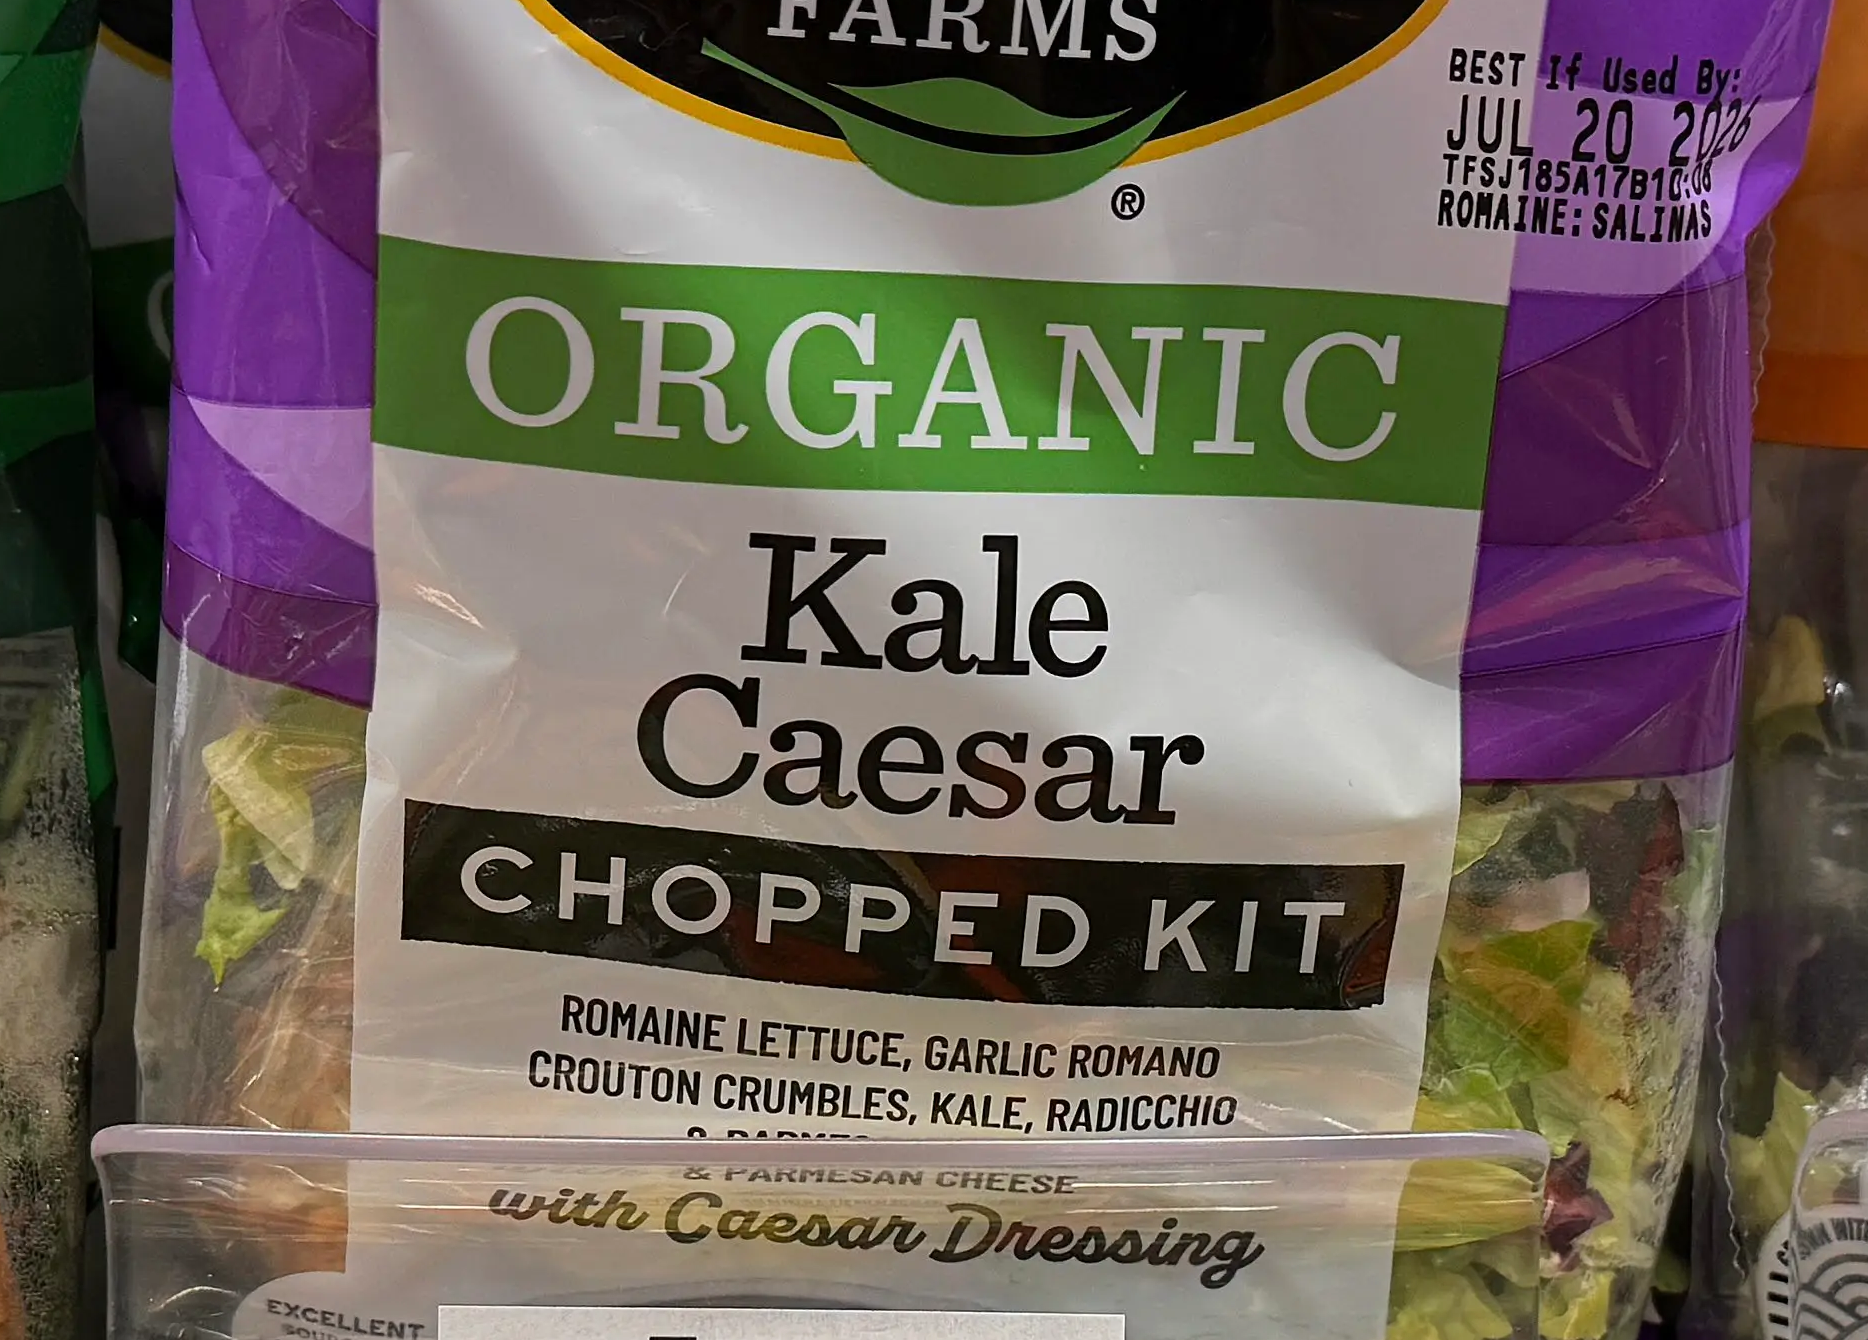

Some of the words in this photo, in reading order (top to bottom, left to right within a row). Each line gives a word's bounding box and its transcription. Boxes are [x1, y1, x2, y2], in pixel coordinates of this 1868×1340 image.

[1449, 48, 1526, 87] BEST
[1545, 53, 1581, 90] If
[1603, 55, 1678, 94] Used
[1696, 56, 1741, 100] By:
[1445, 94, 1534, 156] JUL
[1572, 99, 1634, 164] 20
[1669, 93, 1762, 168] 2026
[463, 295, 1401, 462] ORGANIC
[739, 532, 1111, 678] Kale
[635, 673, 1205, 827] Caesar
[459, 845, 1092, 970] CHOPPED
[1143, 897, 1346, 975] KIT
[560, 994, 725, 1053] ROMAINE
[735, 1016, 912, 1074] LETTUCE,
[924, 1034, 1055, 1080] GARLIC
[1067, 1044, 1220, 1080] ROMANO
[528, 1050, 701, 1108] CROUTON
[712, 1072, 917, 1128] CRUMBLES,
[931, 1092, 1031, 1134] KALE,
[1046, 1094, 1237, 1132] RADICCHIO
